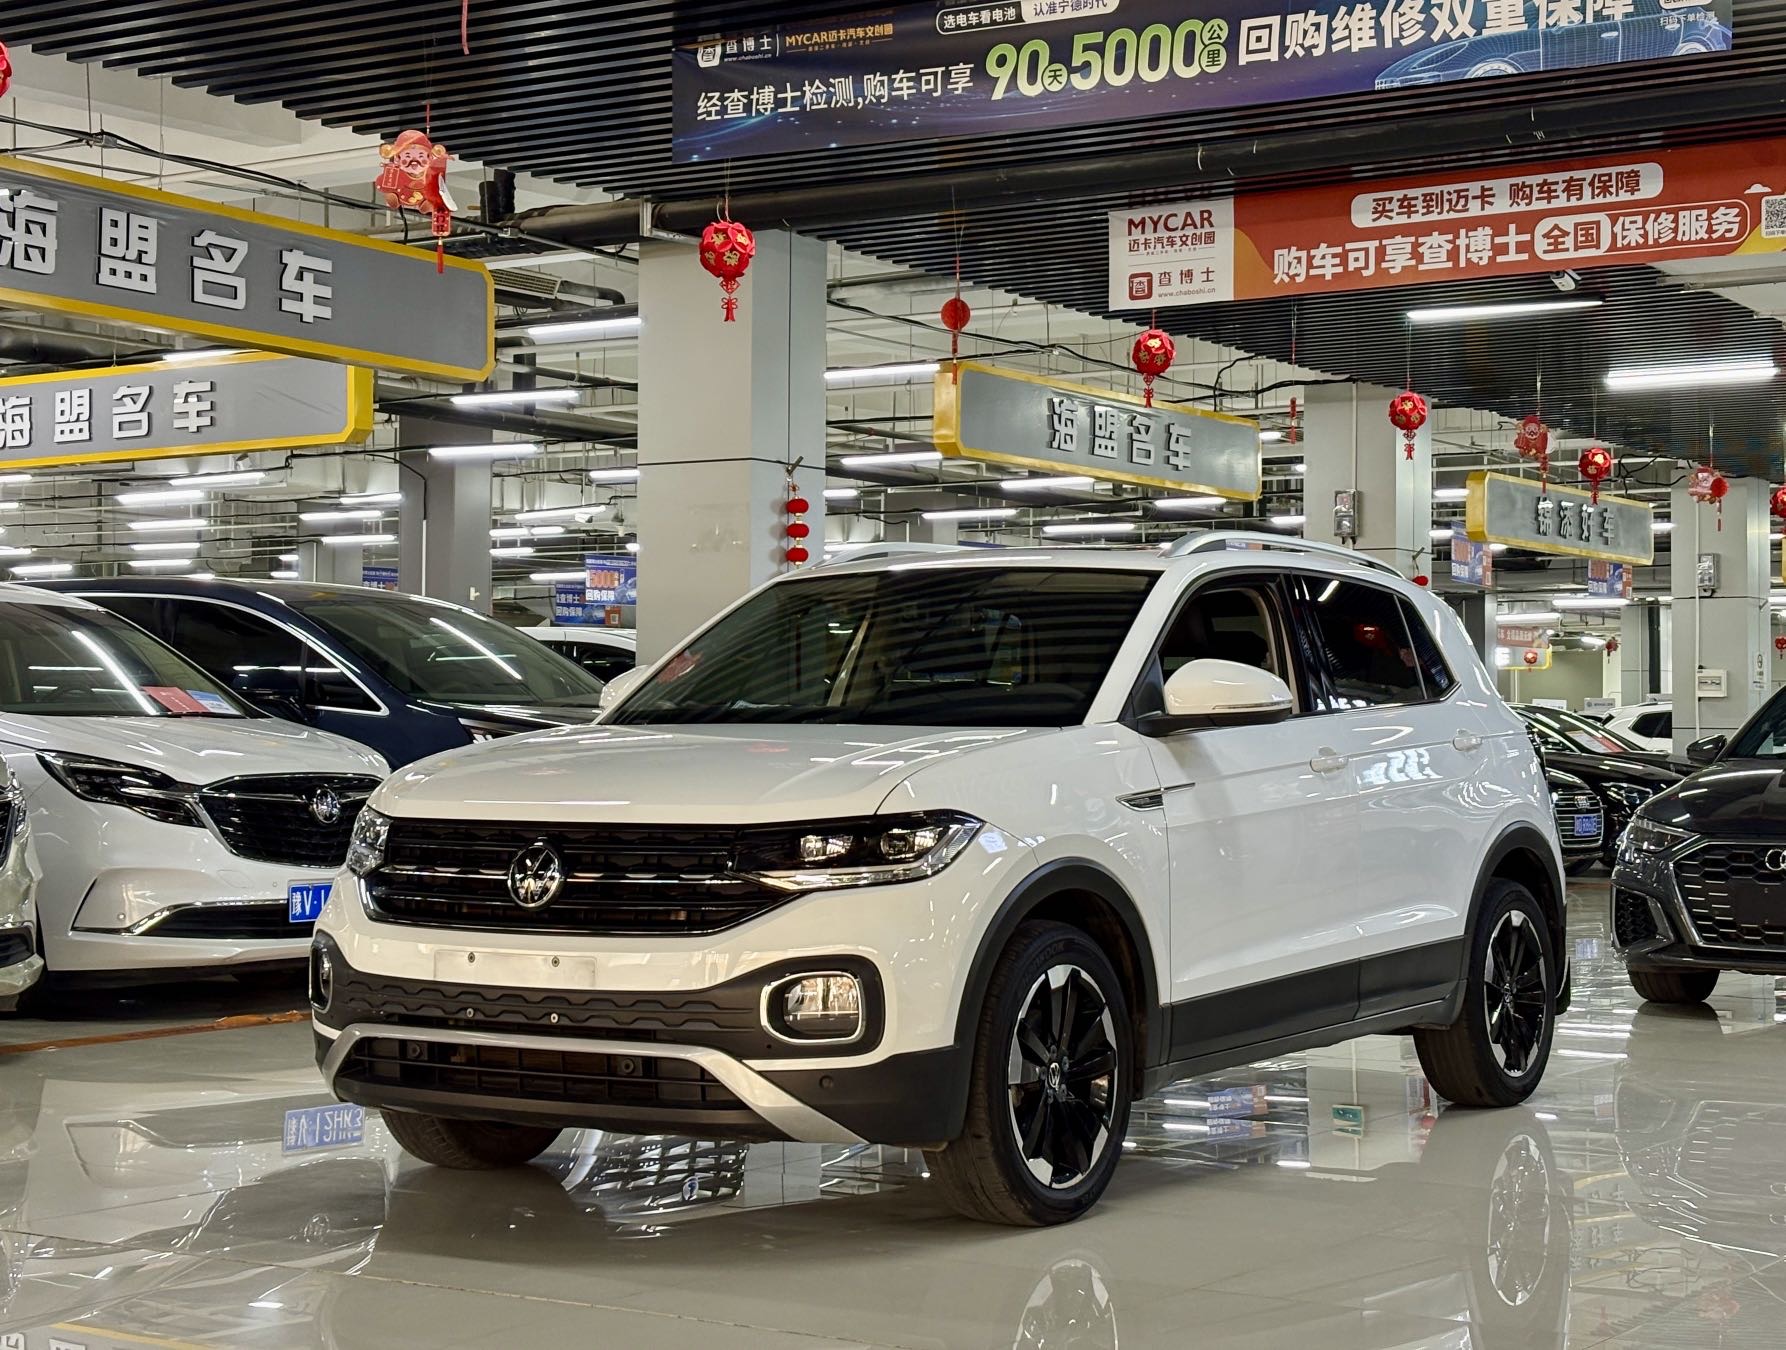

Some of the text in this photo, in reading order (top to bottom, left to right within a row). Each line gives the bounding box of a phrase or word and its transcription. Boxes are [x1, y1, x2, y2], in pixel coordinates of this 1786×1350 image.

[943, 7, 1016, 29] 选电车看电池
[1371, 169, 1641, 222] 买车到迈卡 购车有保障
[1127, 209, 1214, 236] MYCAR
[1128, 231, 1215, 252] 迈卡汽车文创园
[0, 188, 333, 323] 海盟名车
[1158, 266, 1215, 287] 查博士
[0, 380, 213, 448] 海盟名车
[1051, 397, 1192, 471] 海盟名车
